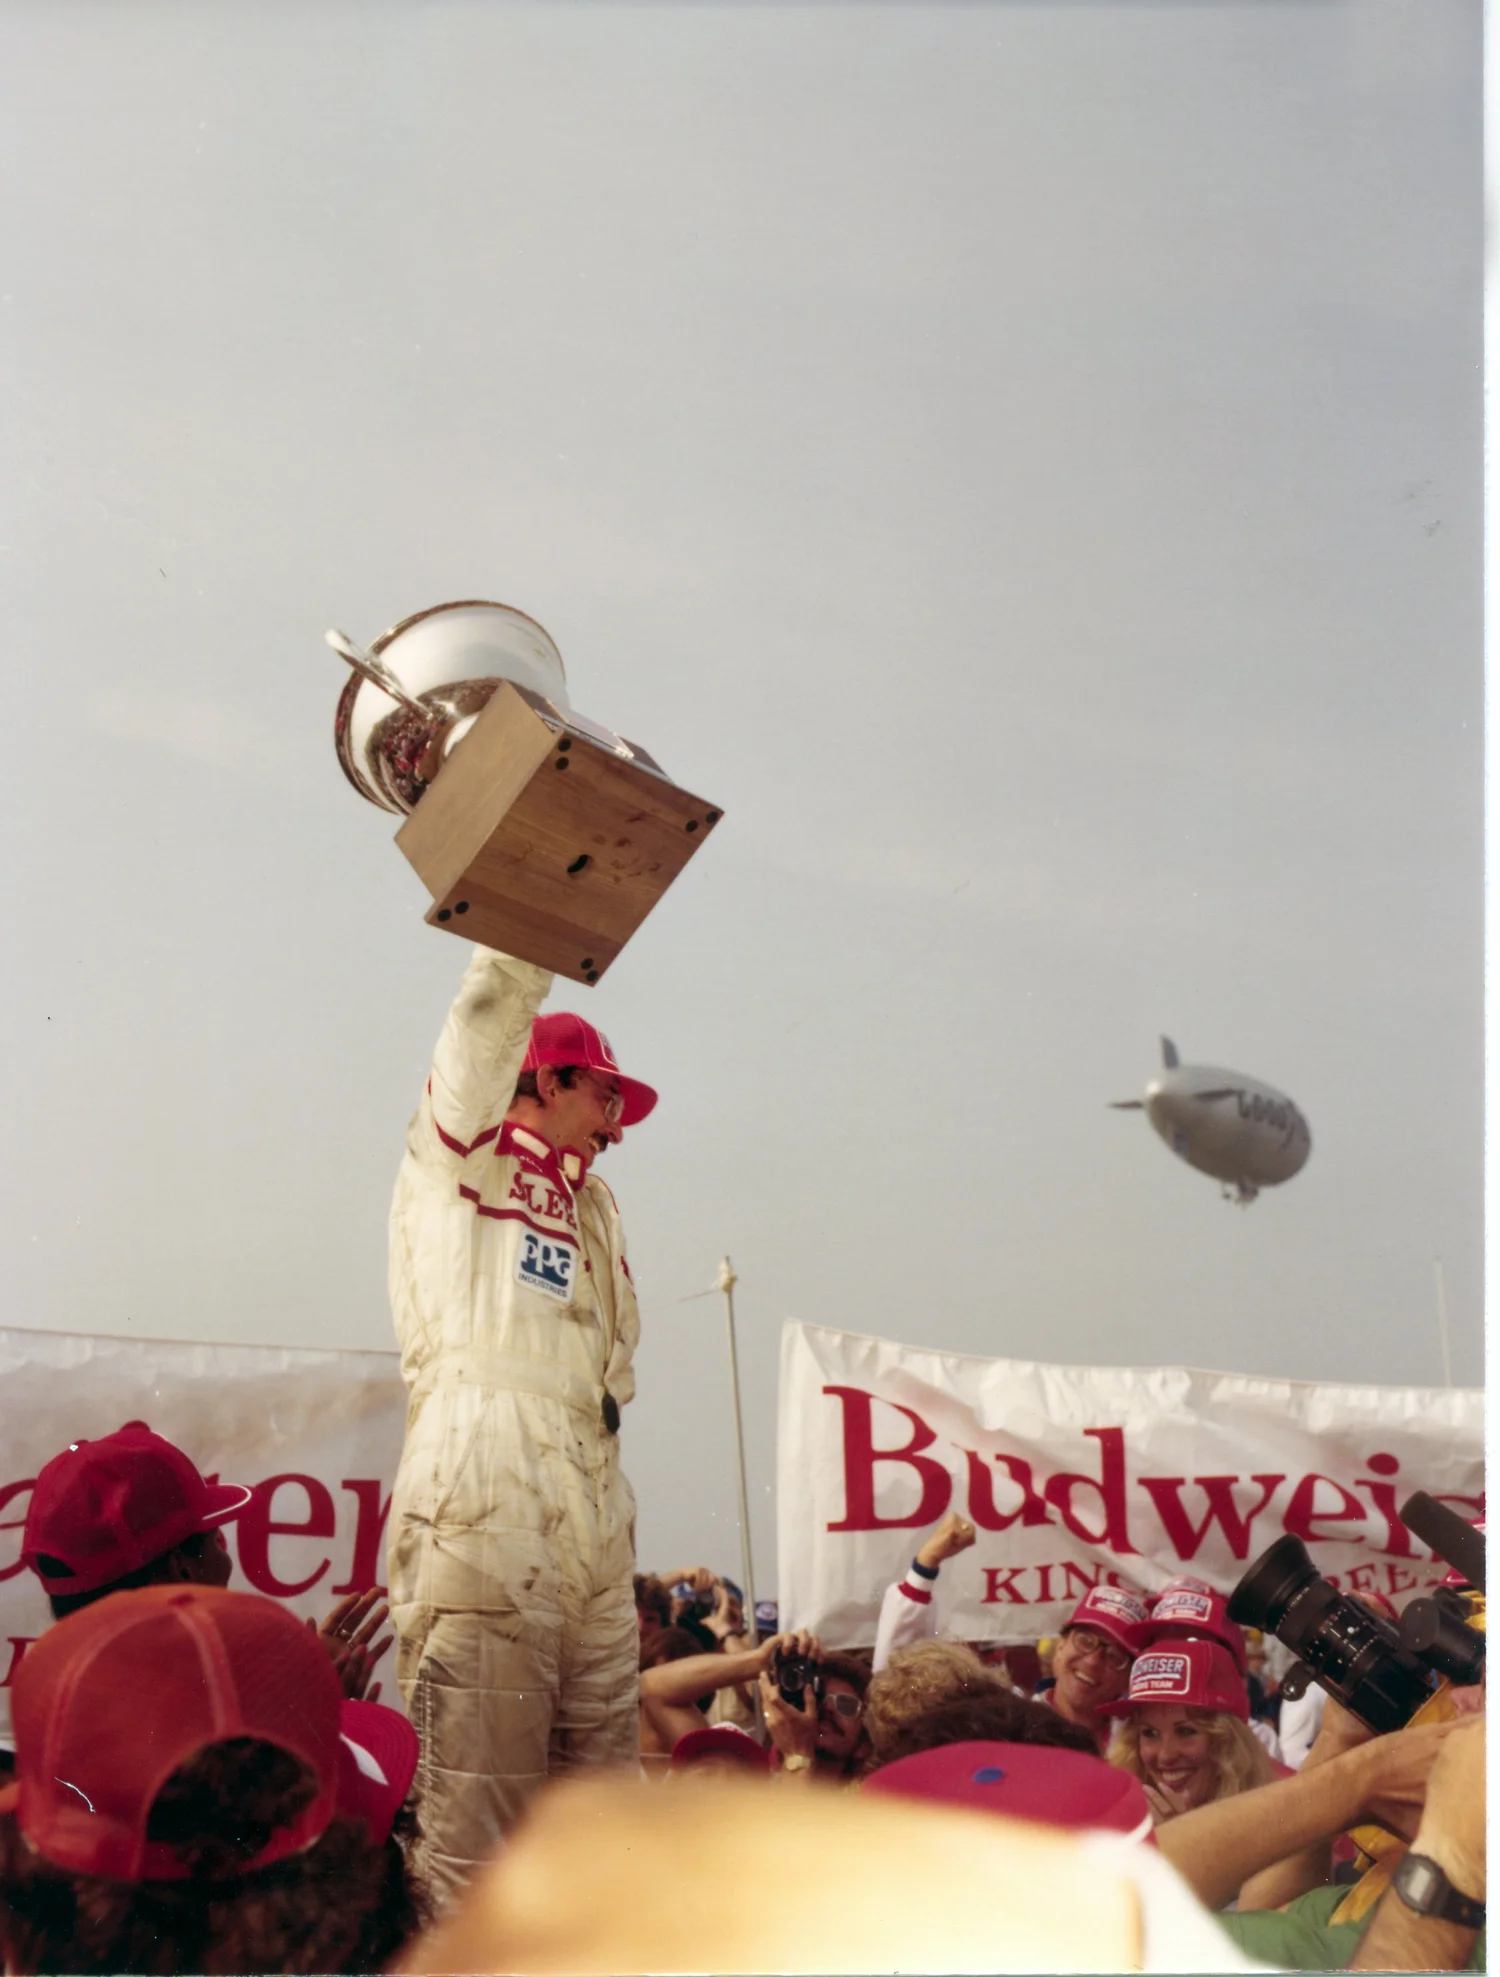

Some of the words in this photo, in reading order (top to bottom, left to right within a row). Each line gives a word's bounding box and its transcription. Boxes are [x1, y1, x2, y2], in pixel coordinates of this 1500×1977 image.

[518, 1273, 568, 1298] INDUSTRIES
[521, 1234, 571, 1288] PPG
[822, 1386, 1485, 1562] Budwei
